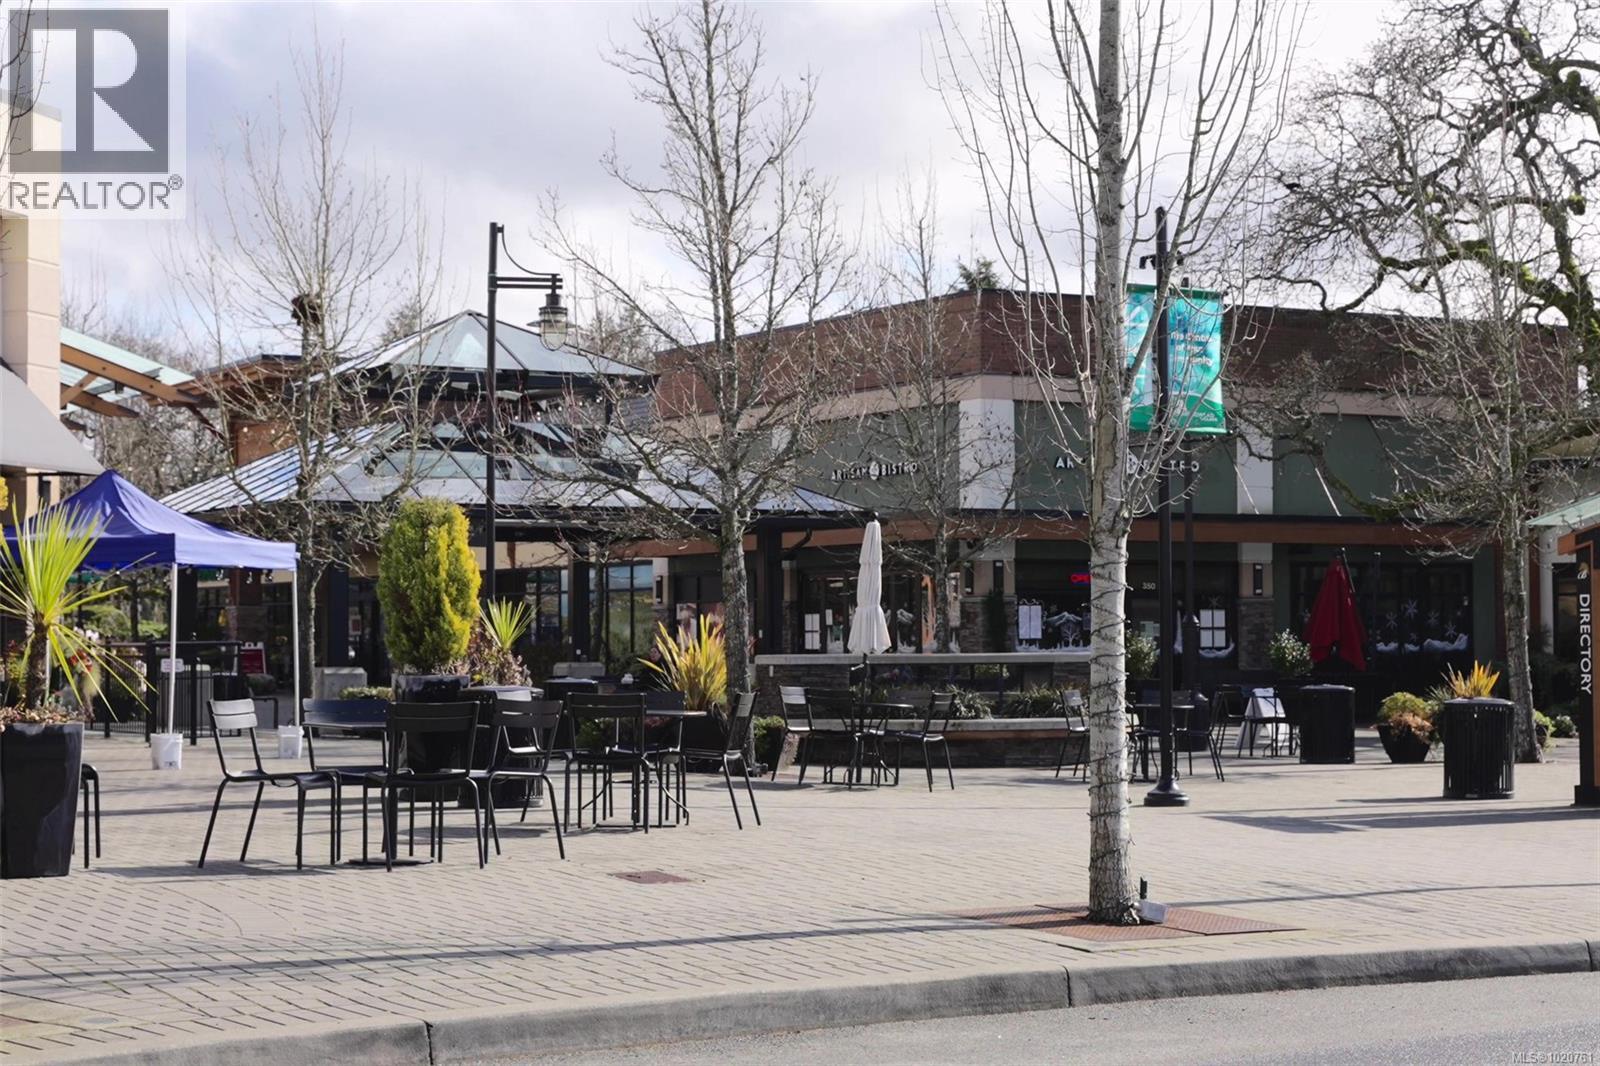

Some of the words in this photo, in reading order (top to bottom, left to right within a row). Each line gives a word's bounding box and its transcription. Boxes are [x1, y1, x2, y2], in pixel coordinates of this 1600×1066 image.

[881, 462, 918, 476] BISTRO
[1071, 574, 1091, 583] OPE
[1578, 593, 1592, 695] DIRECTORY
